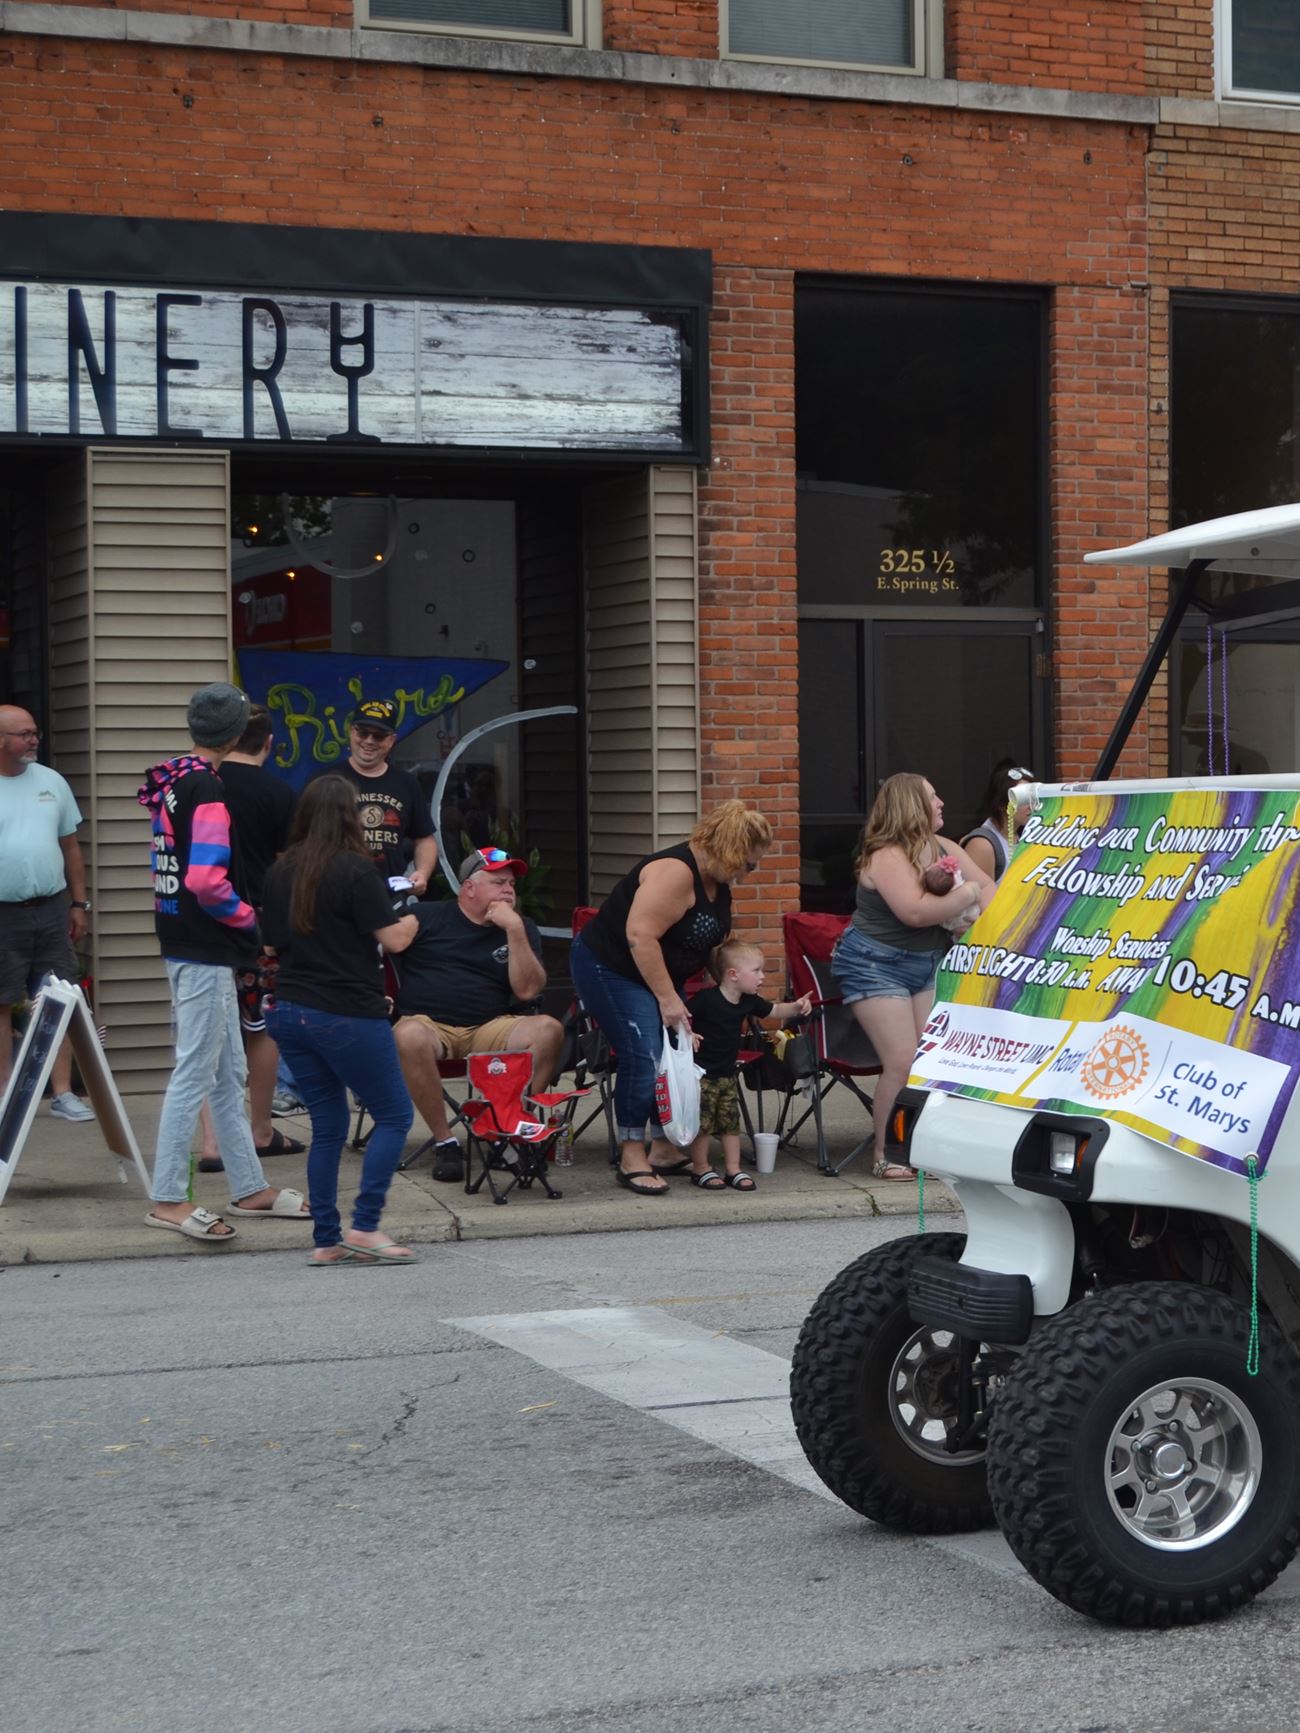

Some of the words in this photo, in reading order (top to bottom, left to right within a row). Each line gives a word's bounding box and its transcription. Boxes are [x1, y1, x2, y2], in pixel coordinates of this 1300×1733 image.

[879, 549, 925, 573] 325
[877, 576, 890, 589] E.
[892, 576, 938, 594] Spring
[942, 577, 959, 590] St.
[267, 674, 465, 767] Ridrs
[355, 792, 403, 811] NESSEE
[1144, 814, 1255, 862] Community
[1021, 856, 1146, 907] Fellowship
[1050, 926, 1112, 962] Worship
[1110, 930, 1173, 960] Services
[940, 943, 982, 973] FIRST
[977, 946, 1035, 983] LIGHT
[1025, 958, 1070, 987] 8:30
[1152, 953, 1251, 1010] 10:45
[941, 1029, 987, 1058] WAYNE
[981, 1035, 1030, 1063] STREET
[1020, 1043, 1055, 1065] UMC
[1172, 1062, 1218, 1090] Club
[1221, 1081, 1247, 1099] of
[1154, 1083, 1179, 1107] St.
[1187, 1096, 1251, 1134] Marys
